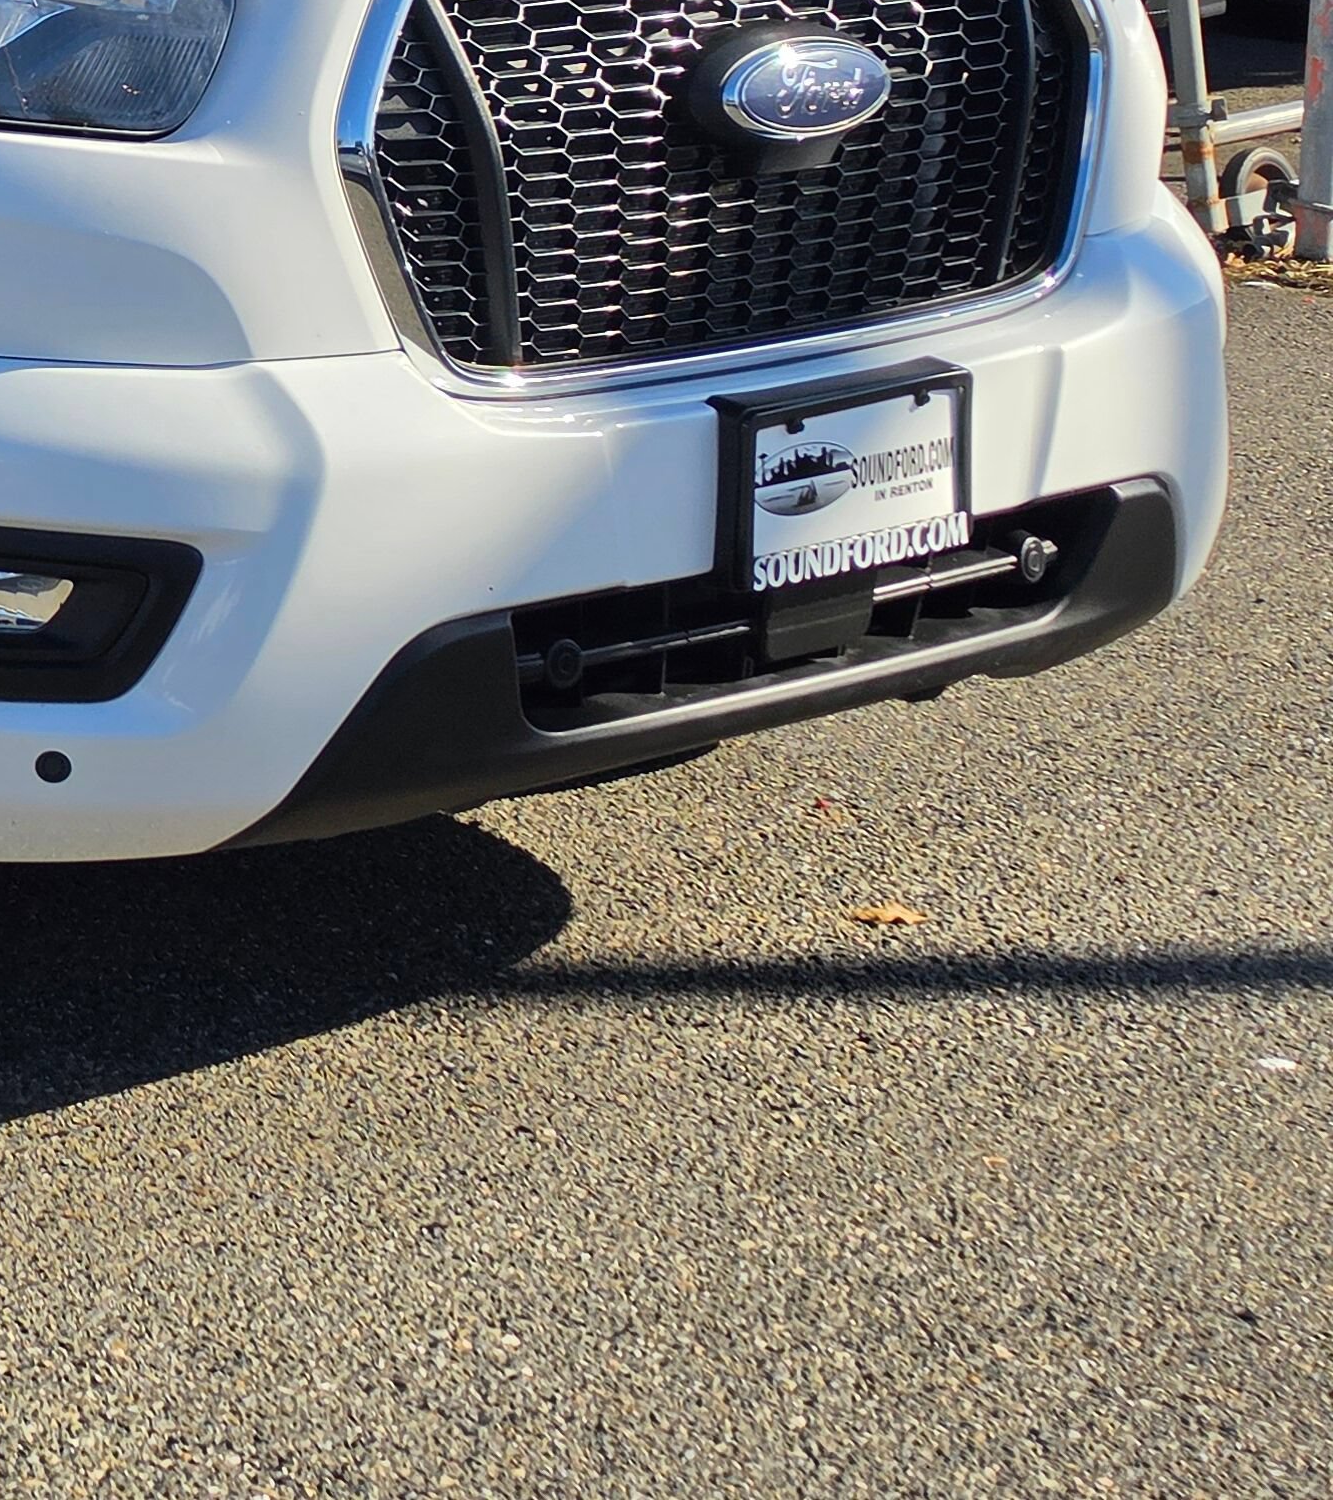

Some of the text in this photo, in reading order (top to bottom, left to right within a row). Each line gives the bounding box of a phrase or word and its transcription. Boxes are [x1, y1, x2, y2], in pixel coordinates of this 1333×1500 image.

[767, 49, 866, 120] Ford
[851, 435, 955, 490] SOUNDFORD.COM
[874, 477, 933, 501] IN RENTON
[753, 510, 970, 592] SOUNDFORD.COM
